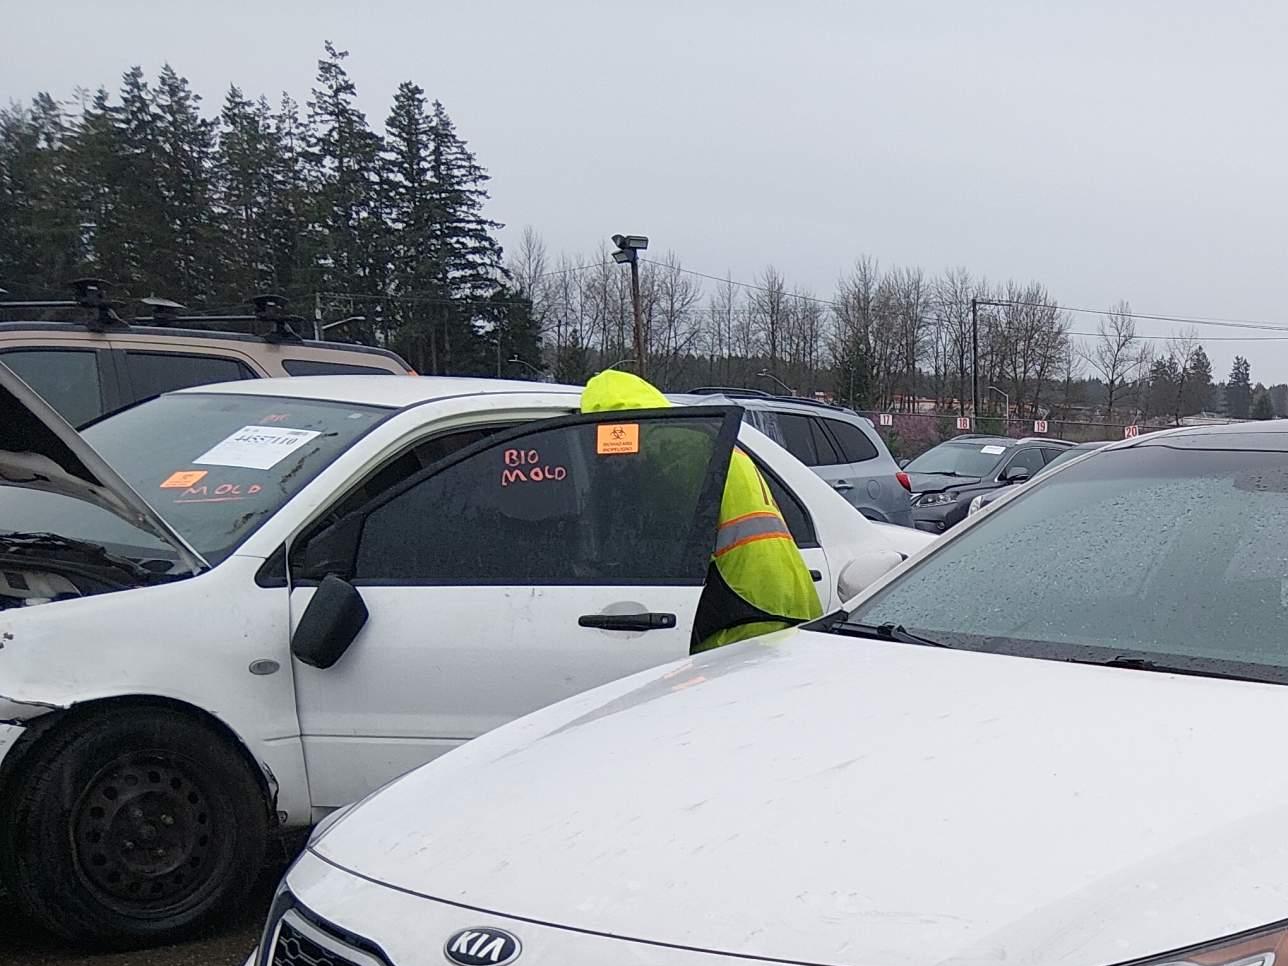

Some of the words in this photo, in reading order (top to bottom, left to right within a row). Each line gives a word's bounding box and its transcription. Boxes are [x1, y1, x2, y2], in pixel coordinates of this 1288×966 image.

[1037, 421, 1045, 431] 19
[1126, 426, 1137, 437] 20
[504, 450, 538, 466] BIO
[502, 466, 566, 486] MOLD
[181, 484, 263, 497] MOLD
[450, 931, 506, 962] KIA
